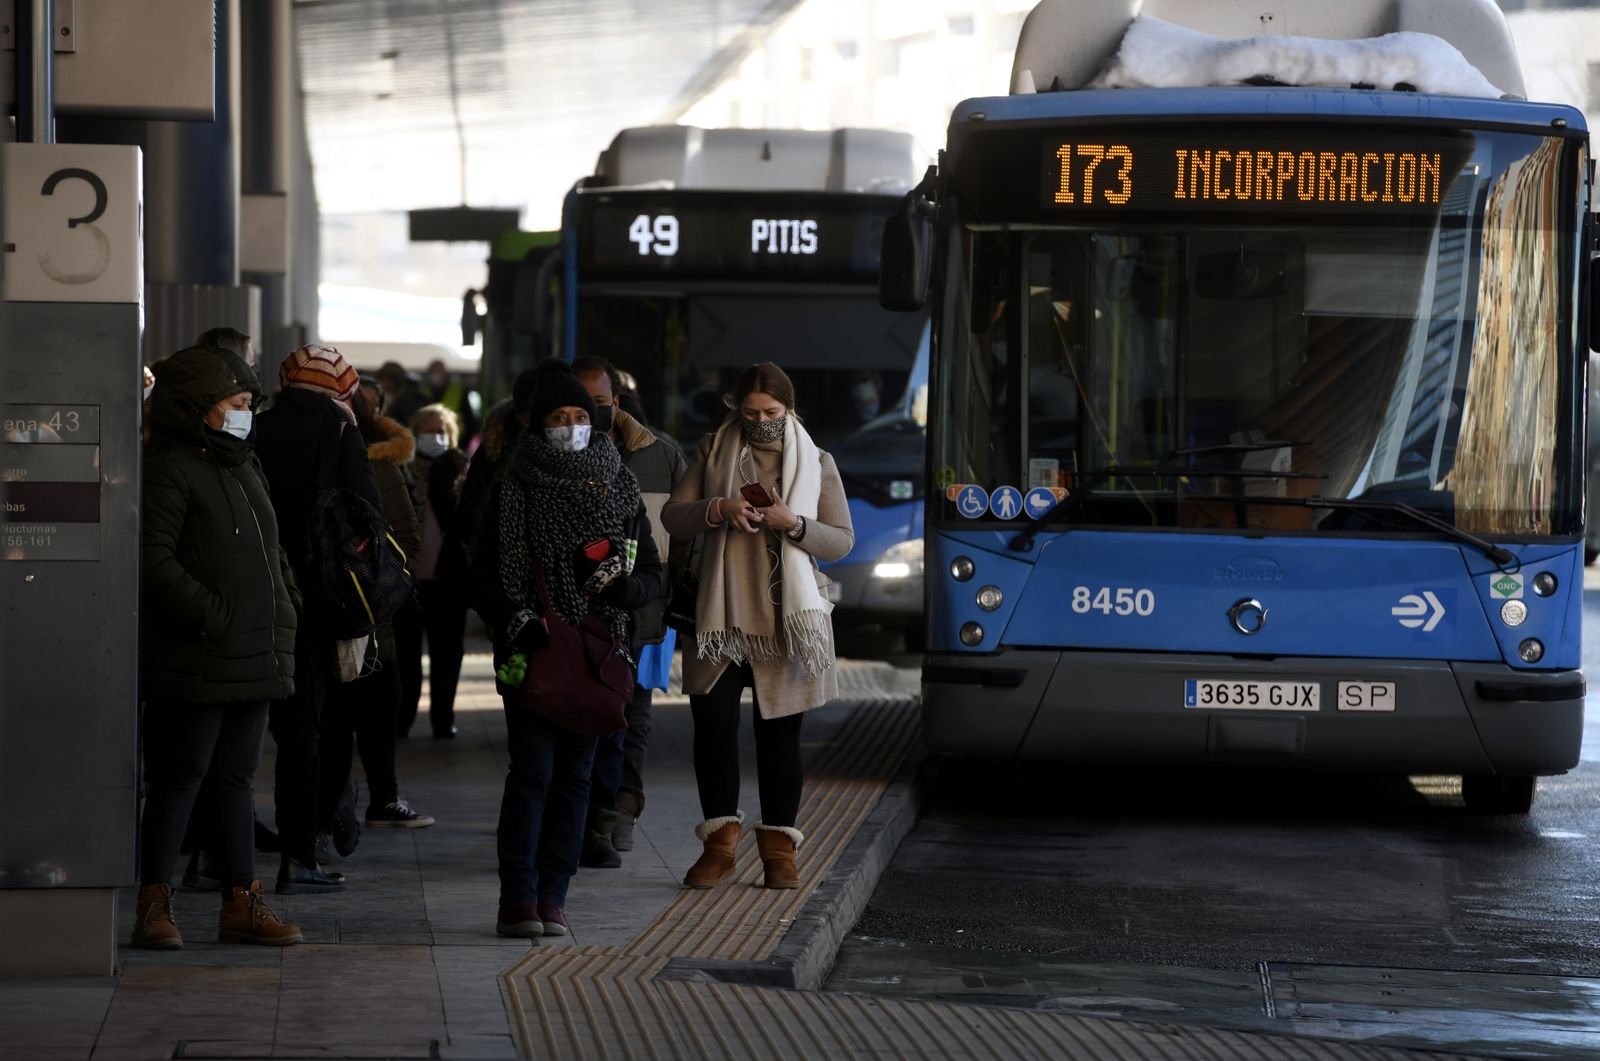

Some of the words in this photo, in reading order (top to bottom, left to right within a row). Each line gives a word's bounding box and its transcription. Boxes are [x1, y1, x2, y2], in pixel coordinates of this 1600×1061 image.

[1055, 144, 1133, 204] 173
[1174, 150, 1440, 202] INCORPORACION
[37, 168, 111, 285] 3
[629, 214, 679, 256] 49
[751, 219, 818, 254] PITIS
[49, 411, 80, 432] 43
[1071, 586, 1155, 616] 8450
[1201, 684, 1260, 704] 3635
[1269, 685, 1314, 707] GJX
[1345, 685, 1388, 707] SP
